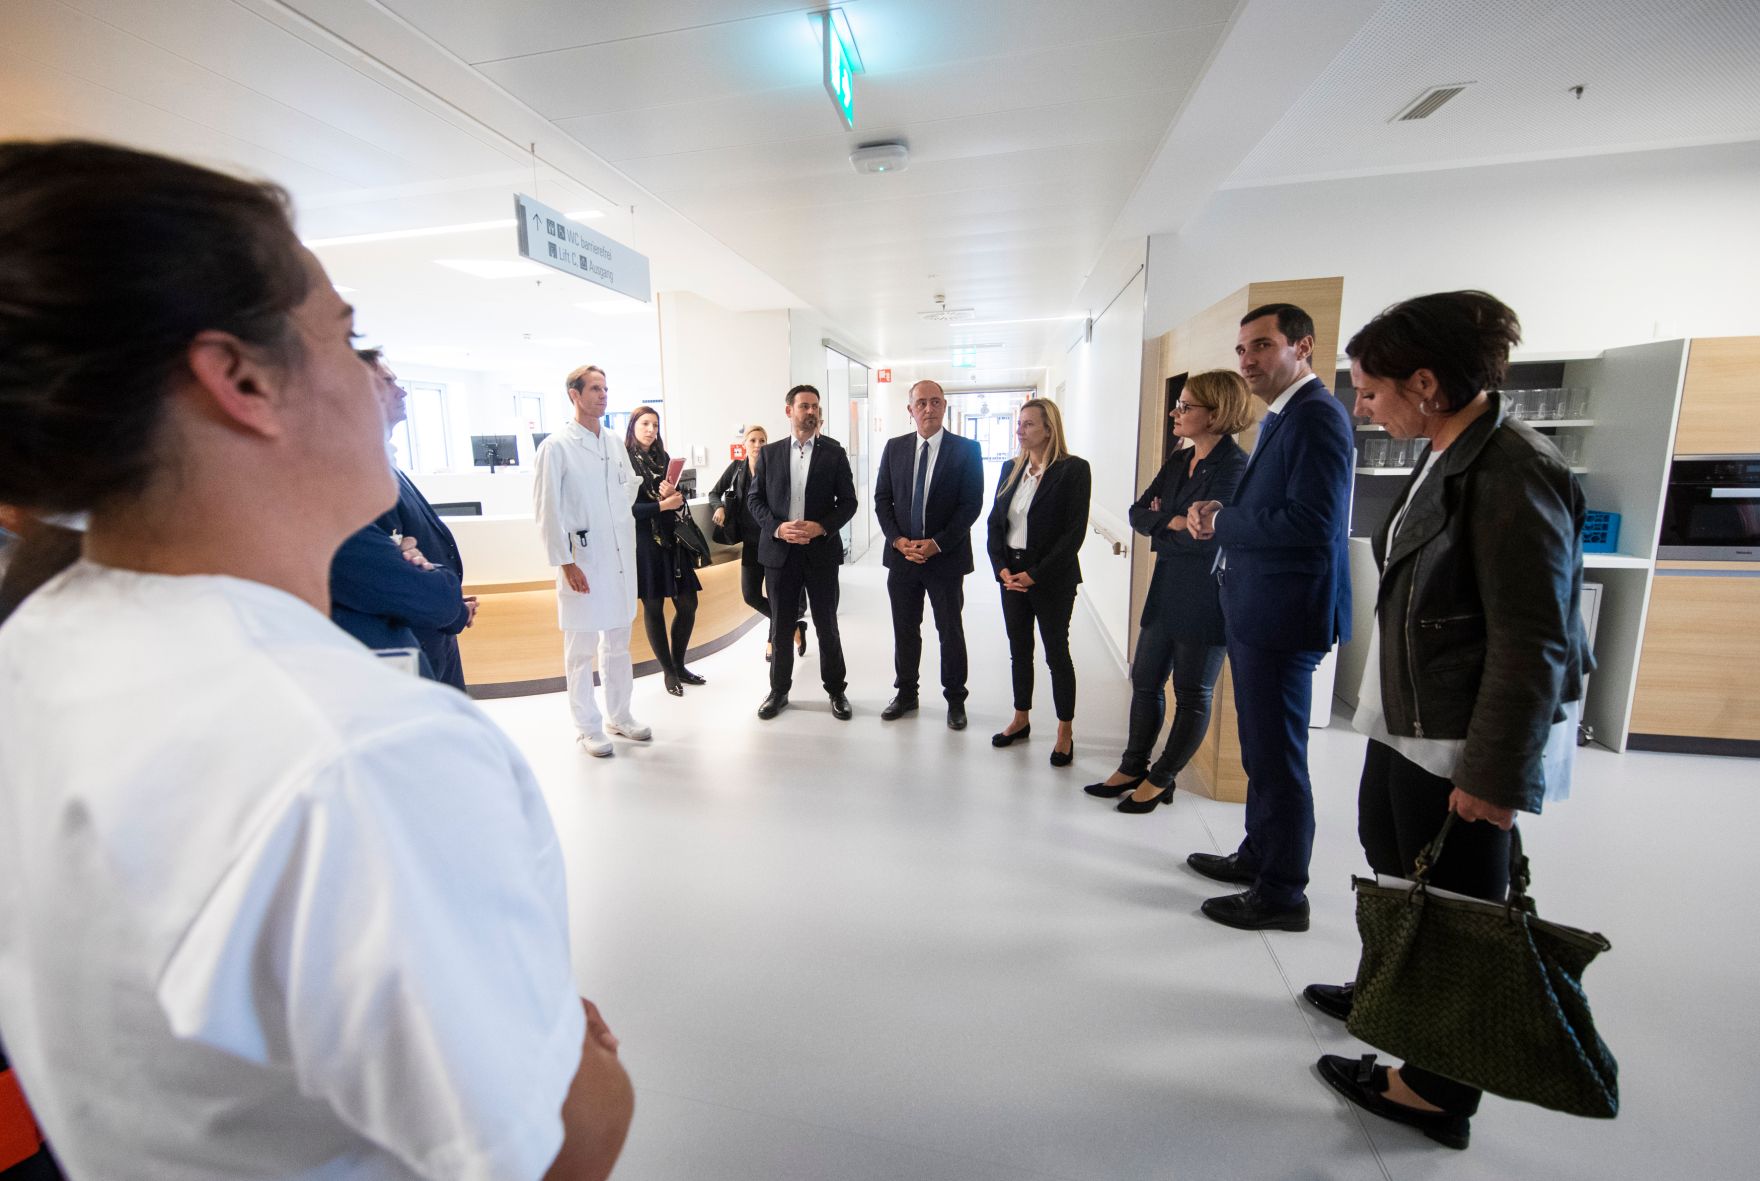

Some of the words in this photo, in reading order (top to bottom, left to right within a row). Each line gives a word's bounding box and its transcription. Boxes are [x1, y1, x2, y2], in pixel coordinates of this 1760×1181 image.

[567, 229, 580, 246] WC
[581, 235, 612, 260] barrierefrei
[559, 247, 571, 263] Lift
[589, 260, 614, 283] Ausgang
